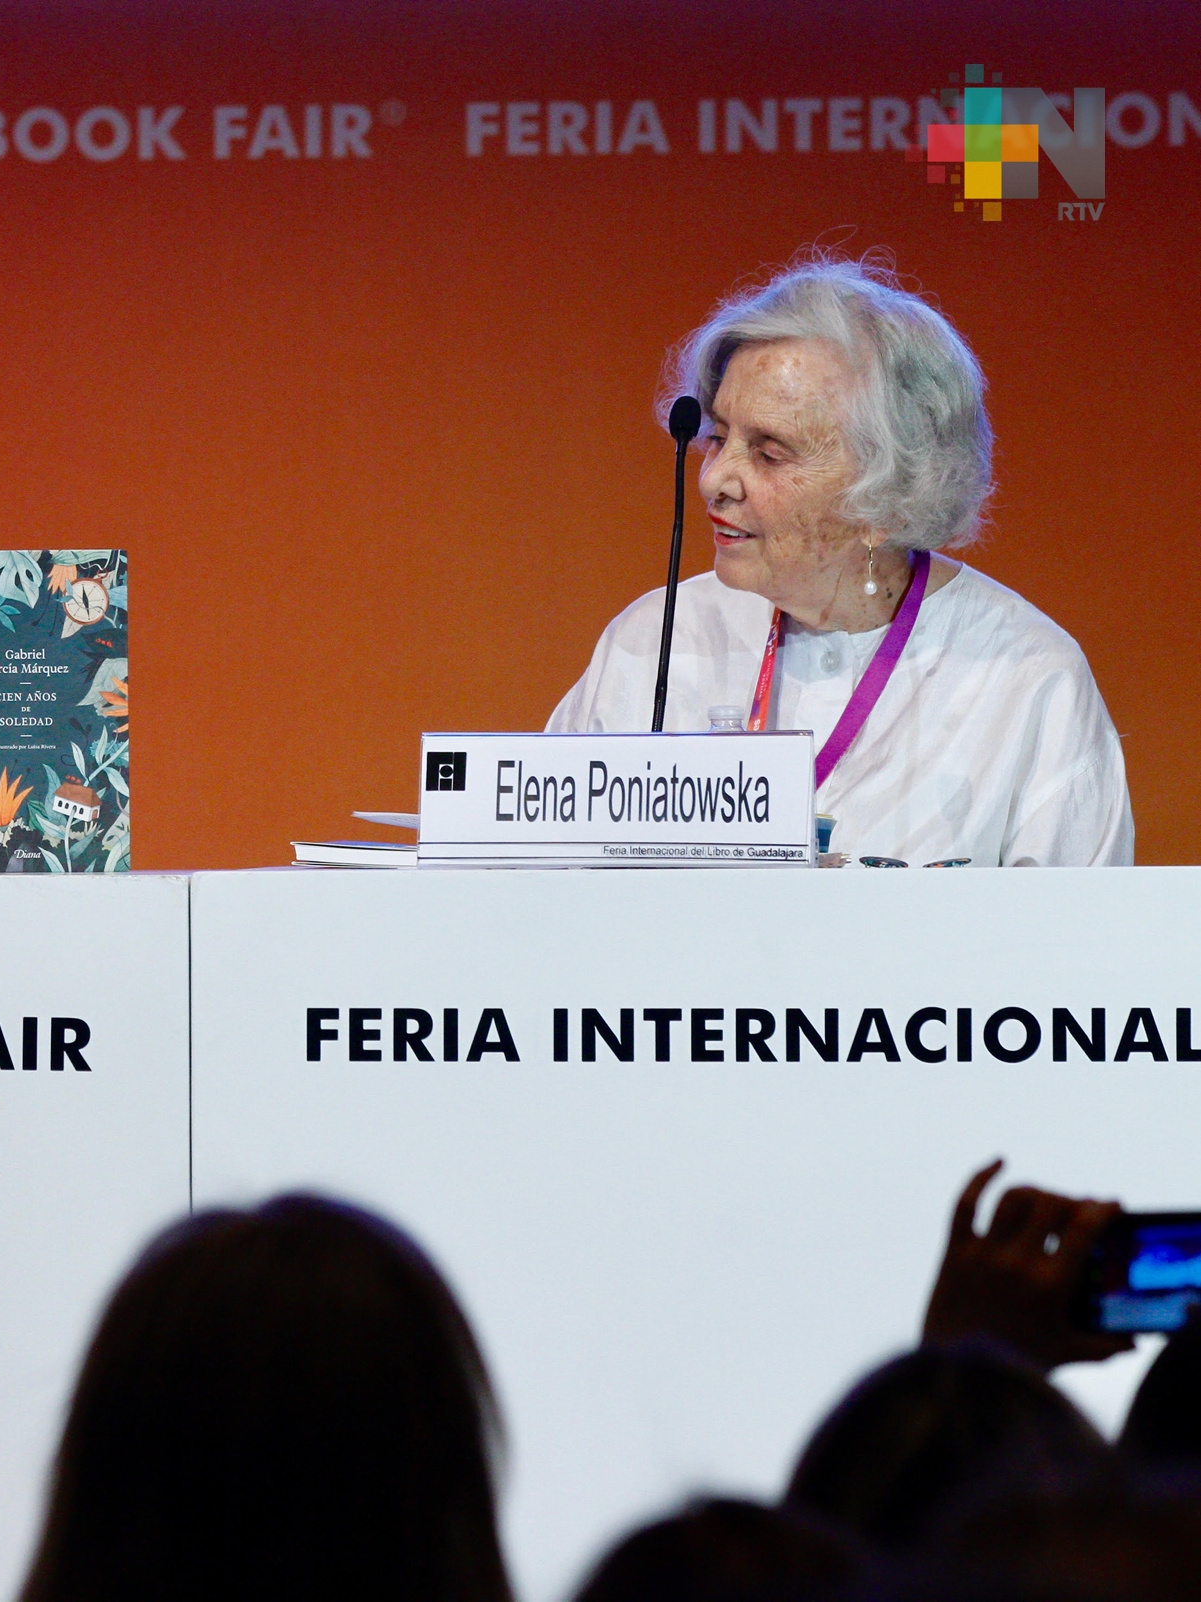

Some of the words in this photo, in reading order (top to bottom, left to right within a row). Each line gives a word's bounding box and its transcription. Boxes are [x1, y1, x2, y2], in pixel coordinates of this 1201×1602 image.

[212, 103, 375, 160] FAIR
[465, 99, 670, 158] FERIA
[5, 649, 46, 661] Gabriel
[21, 663, 69, 676] Márquez
[26, 690, 57, 702] AÑOS
[0, 717, 53, 726] SOLEDAD
[495, 760, 576, 823] Elena
[587, 761, 770, 823] Poniatowska
[13, 849, 41, 859] Diana
[603, 845, 627, 855] Feria
[629, 846, 689, 857] Internacional
[690, 847, 705, 857] del
[707, 847, 732, 858] Libro
[732, 848, 745, 858] de
[746, 848, 804, 862] Guadalajara
[305, 1007, 520, 1062] FERIA
[553, 1007, 1201, 1063] INTERNACIONAL
